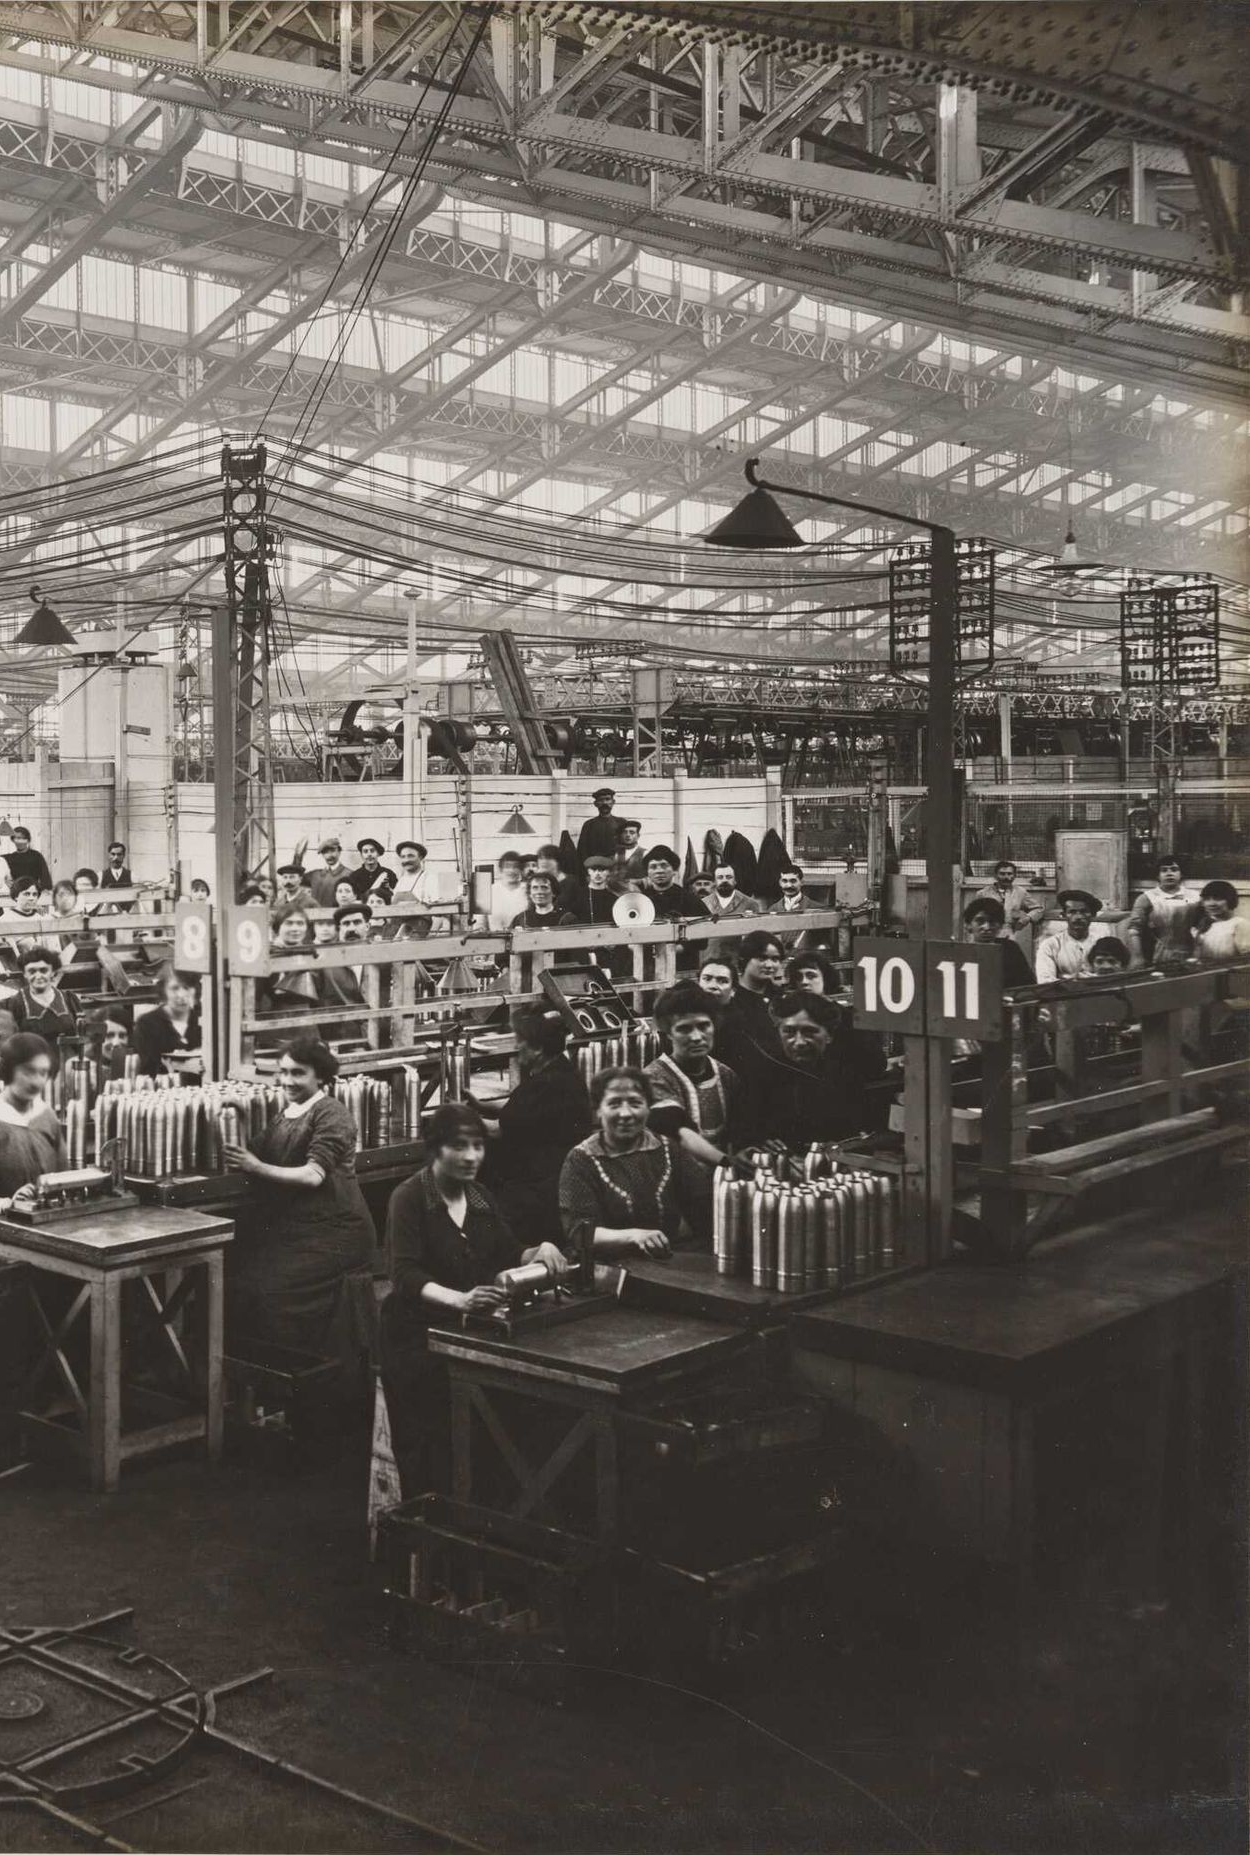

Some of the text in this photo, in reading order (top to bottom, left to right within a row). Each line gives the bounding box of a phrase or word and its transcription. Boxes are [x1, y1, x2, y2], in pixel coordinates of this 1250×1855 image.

[182, 916, 207, 959] 8
[236, 920, 262, 963] 9
[858, 956, 915, 1013] 10
[936, 961, 979, 1020] 11
